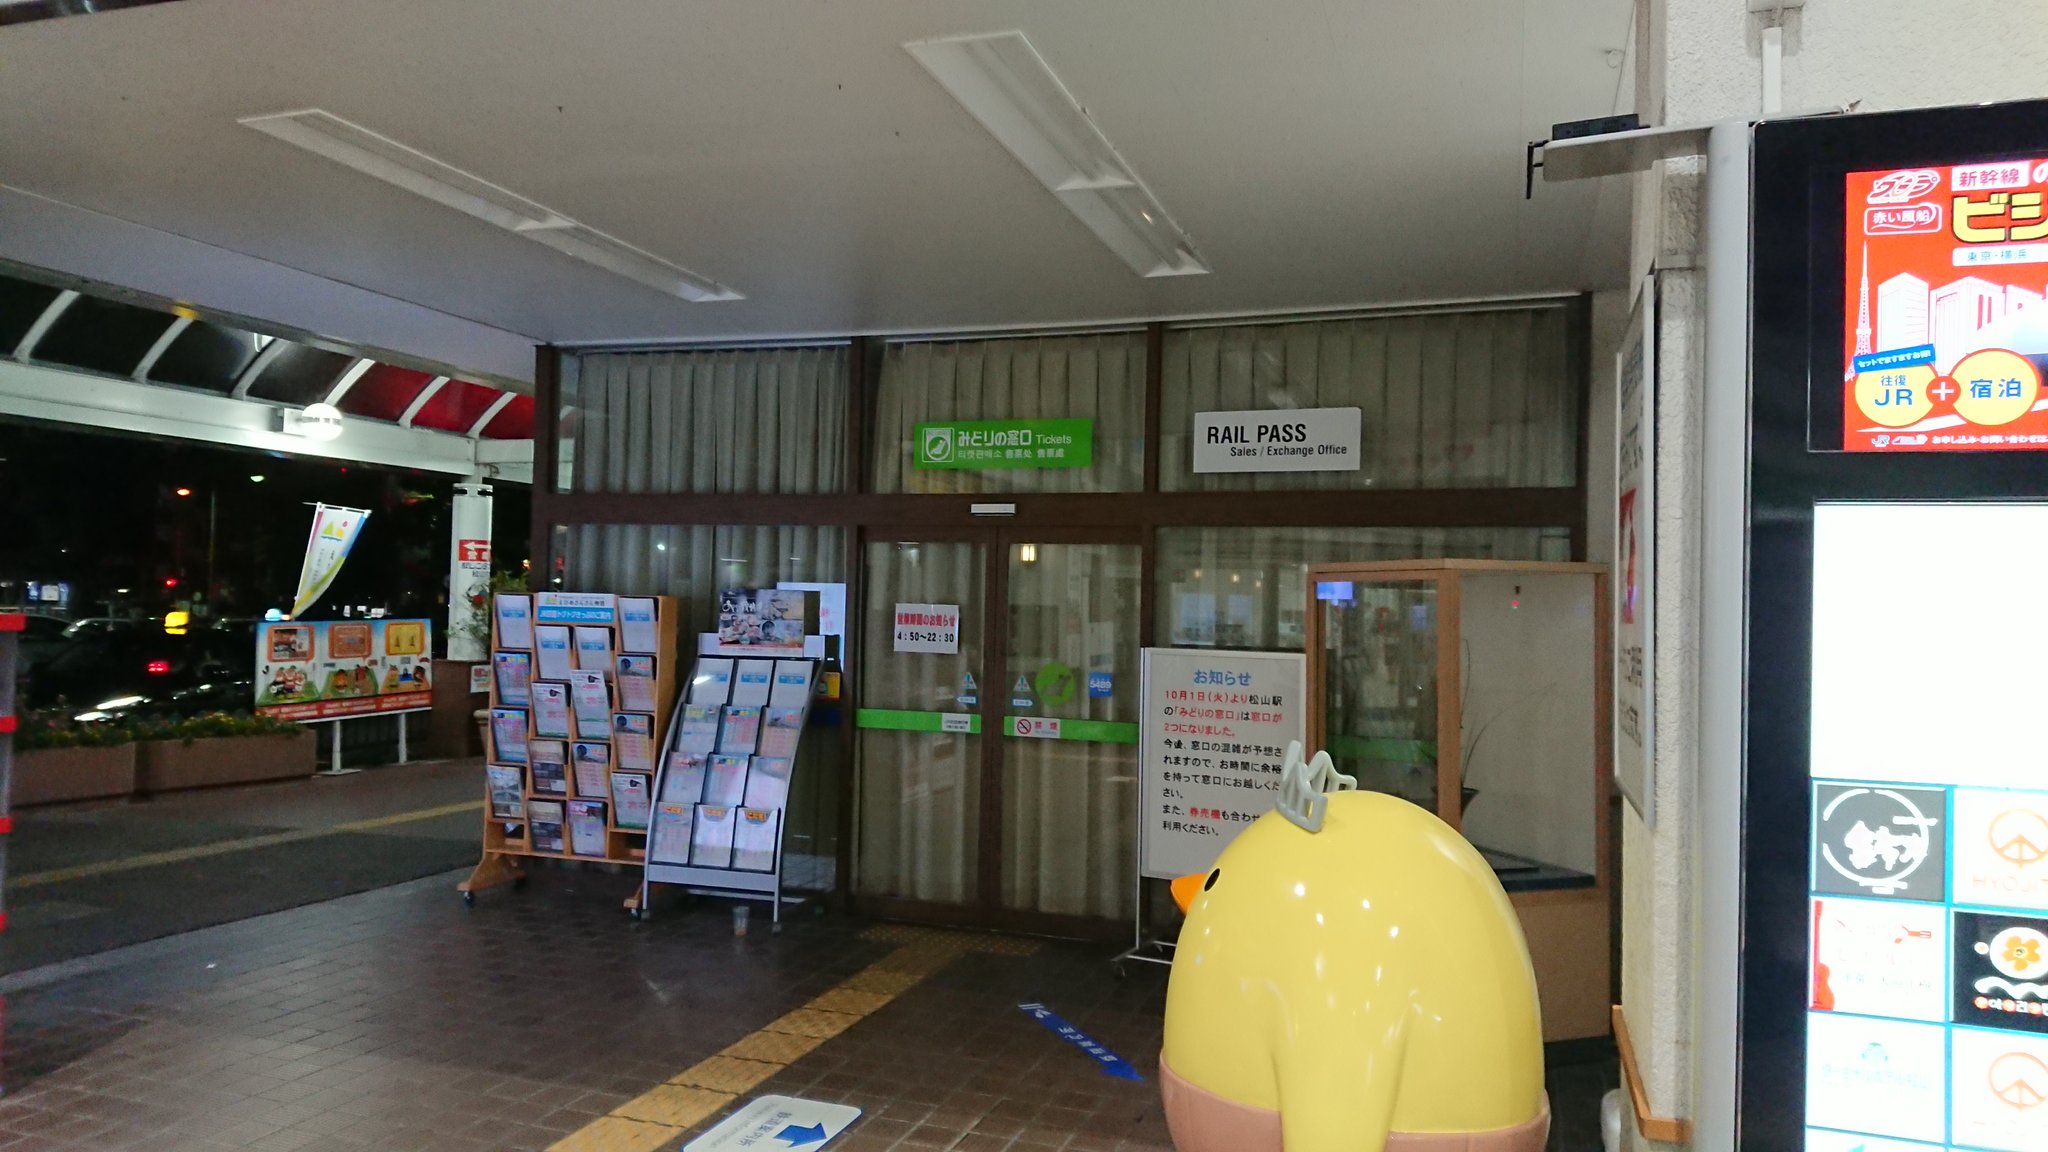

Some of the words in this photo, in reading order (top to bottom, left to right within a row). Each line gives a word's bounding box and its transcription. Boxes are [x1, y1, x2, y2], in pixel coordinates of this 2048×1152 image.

[1959, 168, 2020, 187] 新幹線
[1872, 209, 1931, 225] 赤い風船
[1880, 375, 1907, 387] 往復
[1970, 378, 2023, 400] 宿泊
[1874, 388, 1914, 406] JR
[958, 429, 1032, 447] みどりの窓口
[1036, 433, 1072, 445] Tickets
[1207, 425, 1250, 444] RAIL
[1257, 423, 1307, 443] PASS
[1230, 446, 1257, 457] Sales
[1267, 445, 1314, 458] Exchange
[1317, 444, 1348, 455] Office
[1193, 669, 1252, 687] お知らせ
[1163, 723, 1236, 738] 2つになりました。
[1163, 755, 1283, 775] れますので、お時間に余裕
[1162, 787, 1184, 799] さい。
[1162, 820, 1220, 837] 利用ください。
